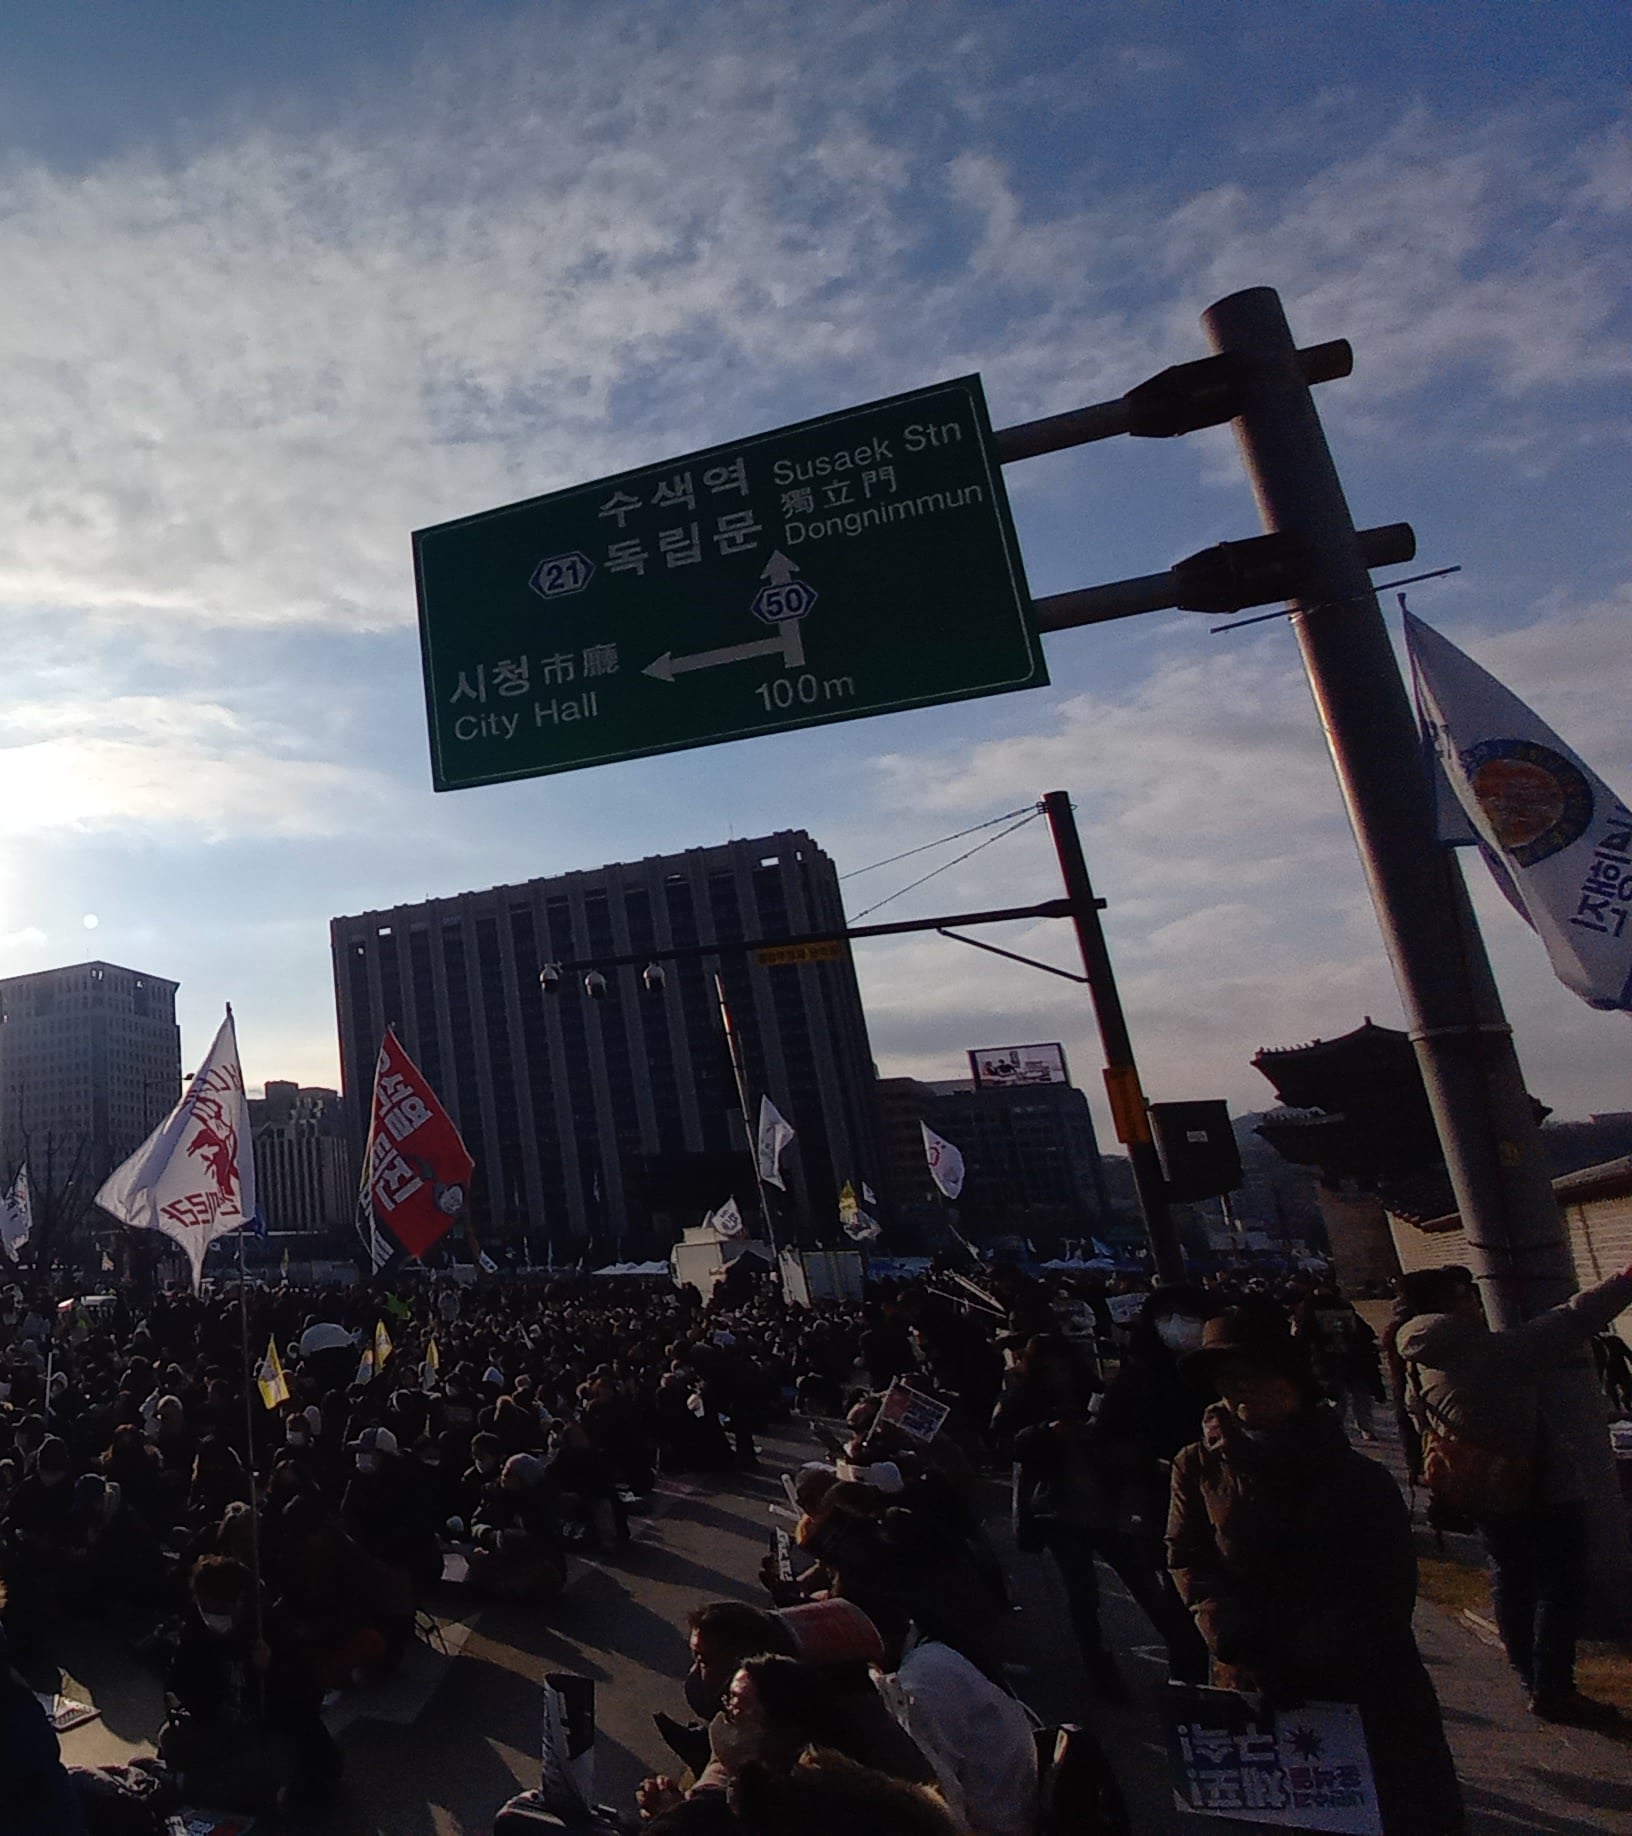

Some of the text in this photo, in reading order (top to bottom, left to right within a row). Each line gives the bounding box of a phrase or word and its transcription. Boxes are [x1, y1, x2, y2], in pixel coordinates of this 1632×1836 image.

[772, 421, 963, 486] Susaek Stn
[597, 455, 750, 528] 수색역
[780, 465, 897, 519] 獨立門
[784, 483, 984, 546] Dongnimmun
[603, 508, 763, 577] 독립문
[546, 562, 580, 592] 21
[766, 587, 803, 617] 50
[449, 641, 621, 704] 시청 市廳
[754, 672, 856, 712] 100m
[454, 690, 599, 741] City Hall
[375, 1047, 434, 1143] 석열
